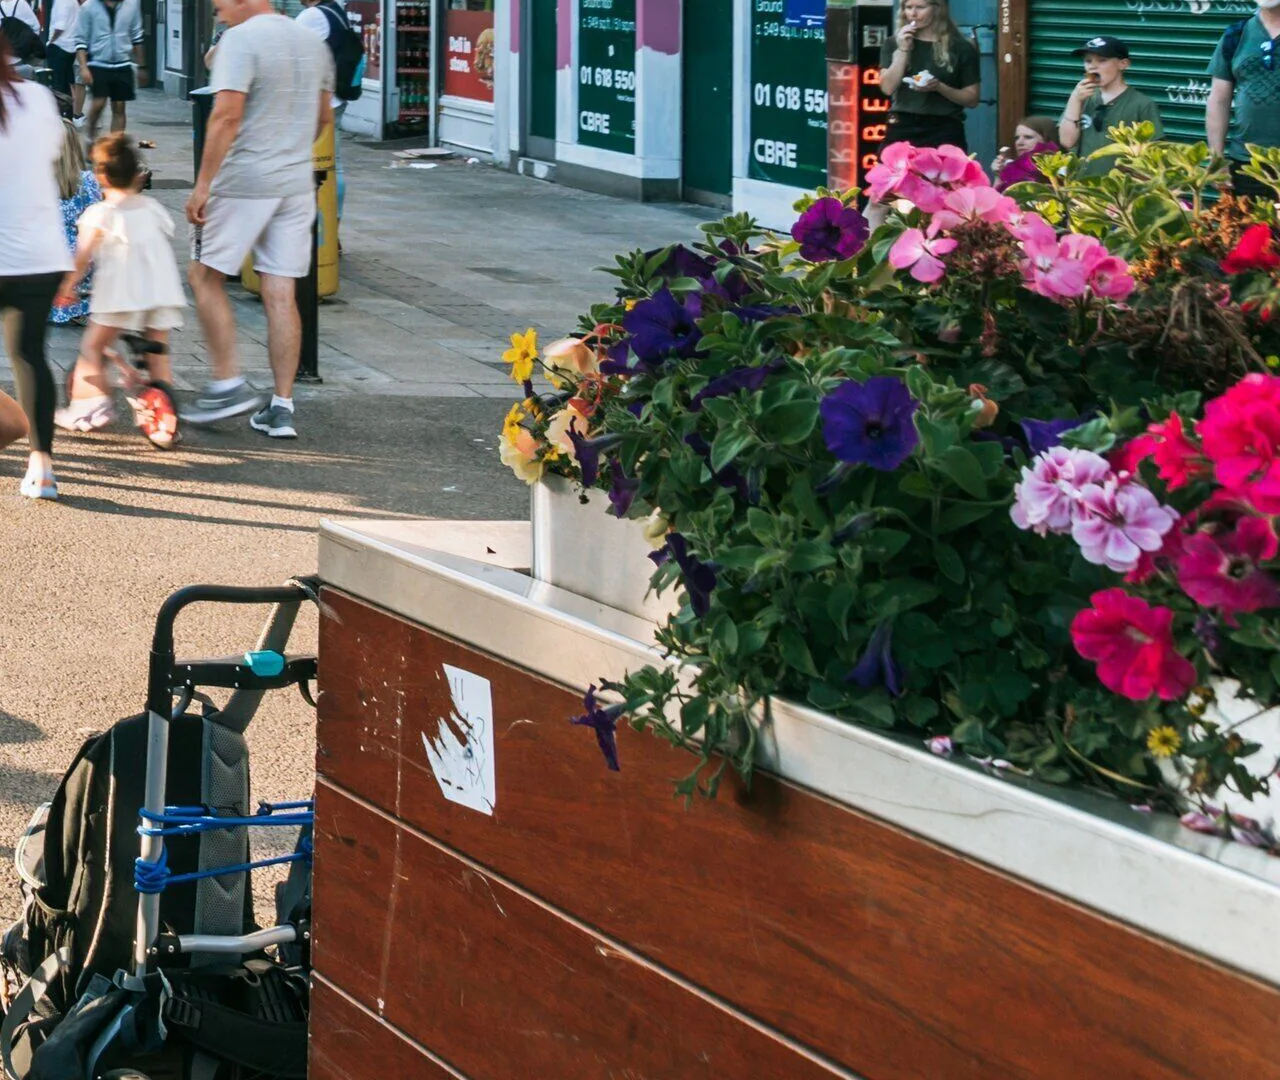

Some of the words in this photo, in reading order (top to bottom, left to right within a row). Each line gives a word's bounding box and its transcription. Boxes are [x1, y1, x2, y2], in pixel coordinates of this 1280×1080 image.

[580, 66, 592, 85] 01
[595, 67, 612, 88] 618
[754, 82, 771, 107] 01
[775, 85, 801, 111] 618
[580, 110, 610, 134] CBRE
[753, 138, 798, 169] CBRE
